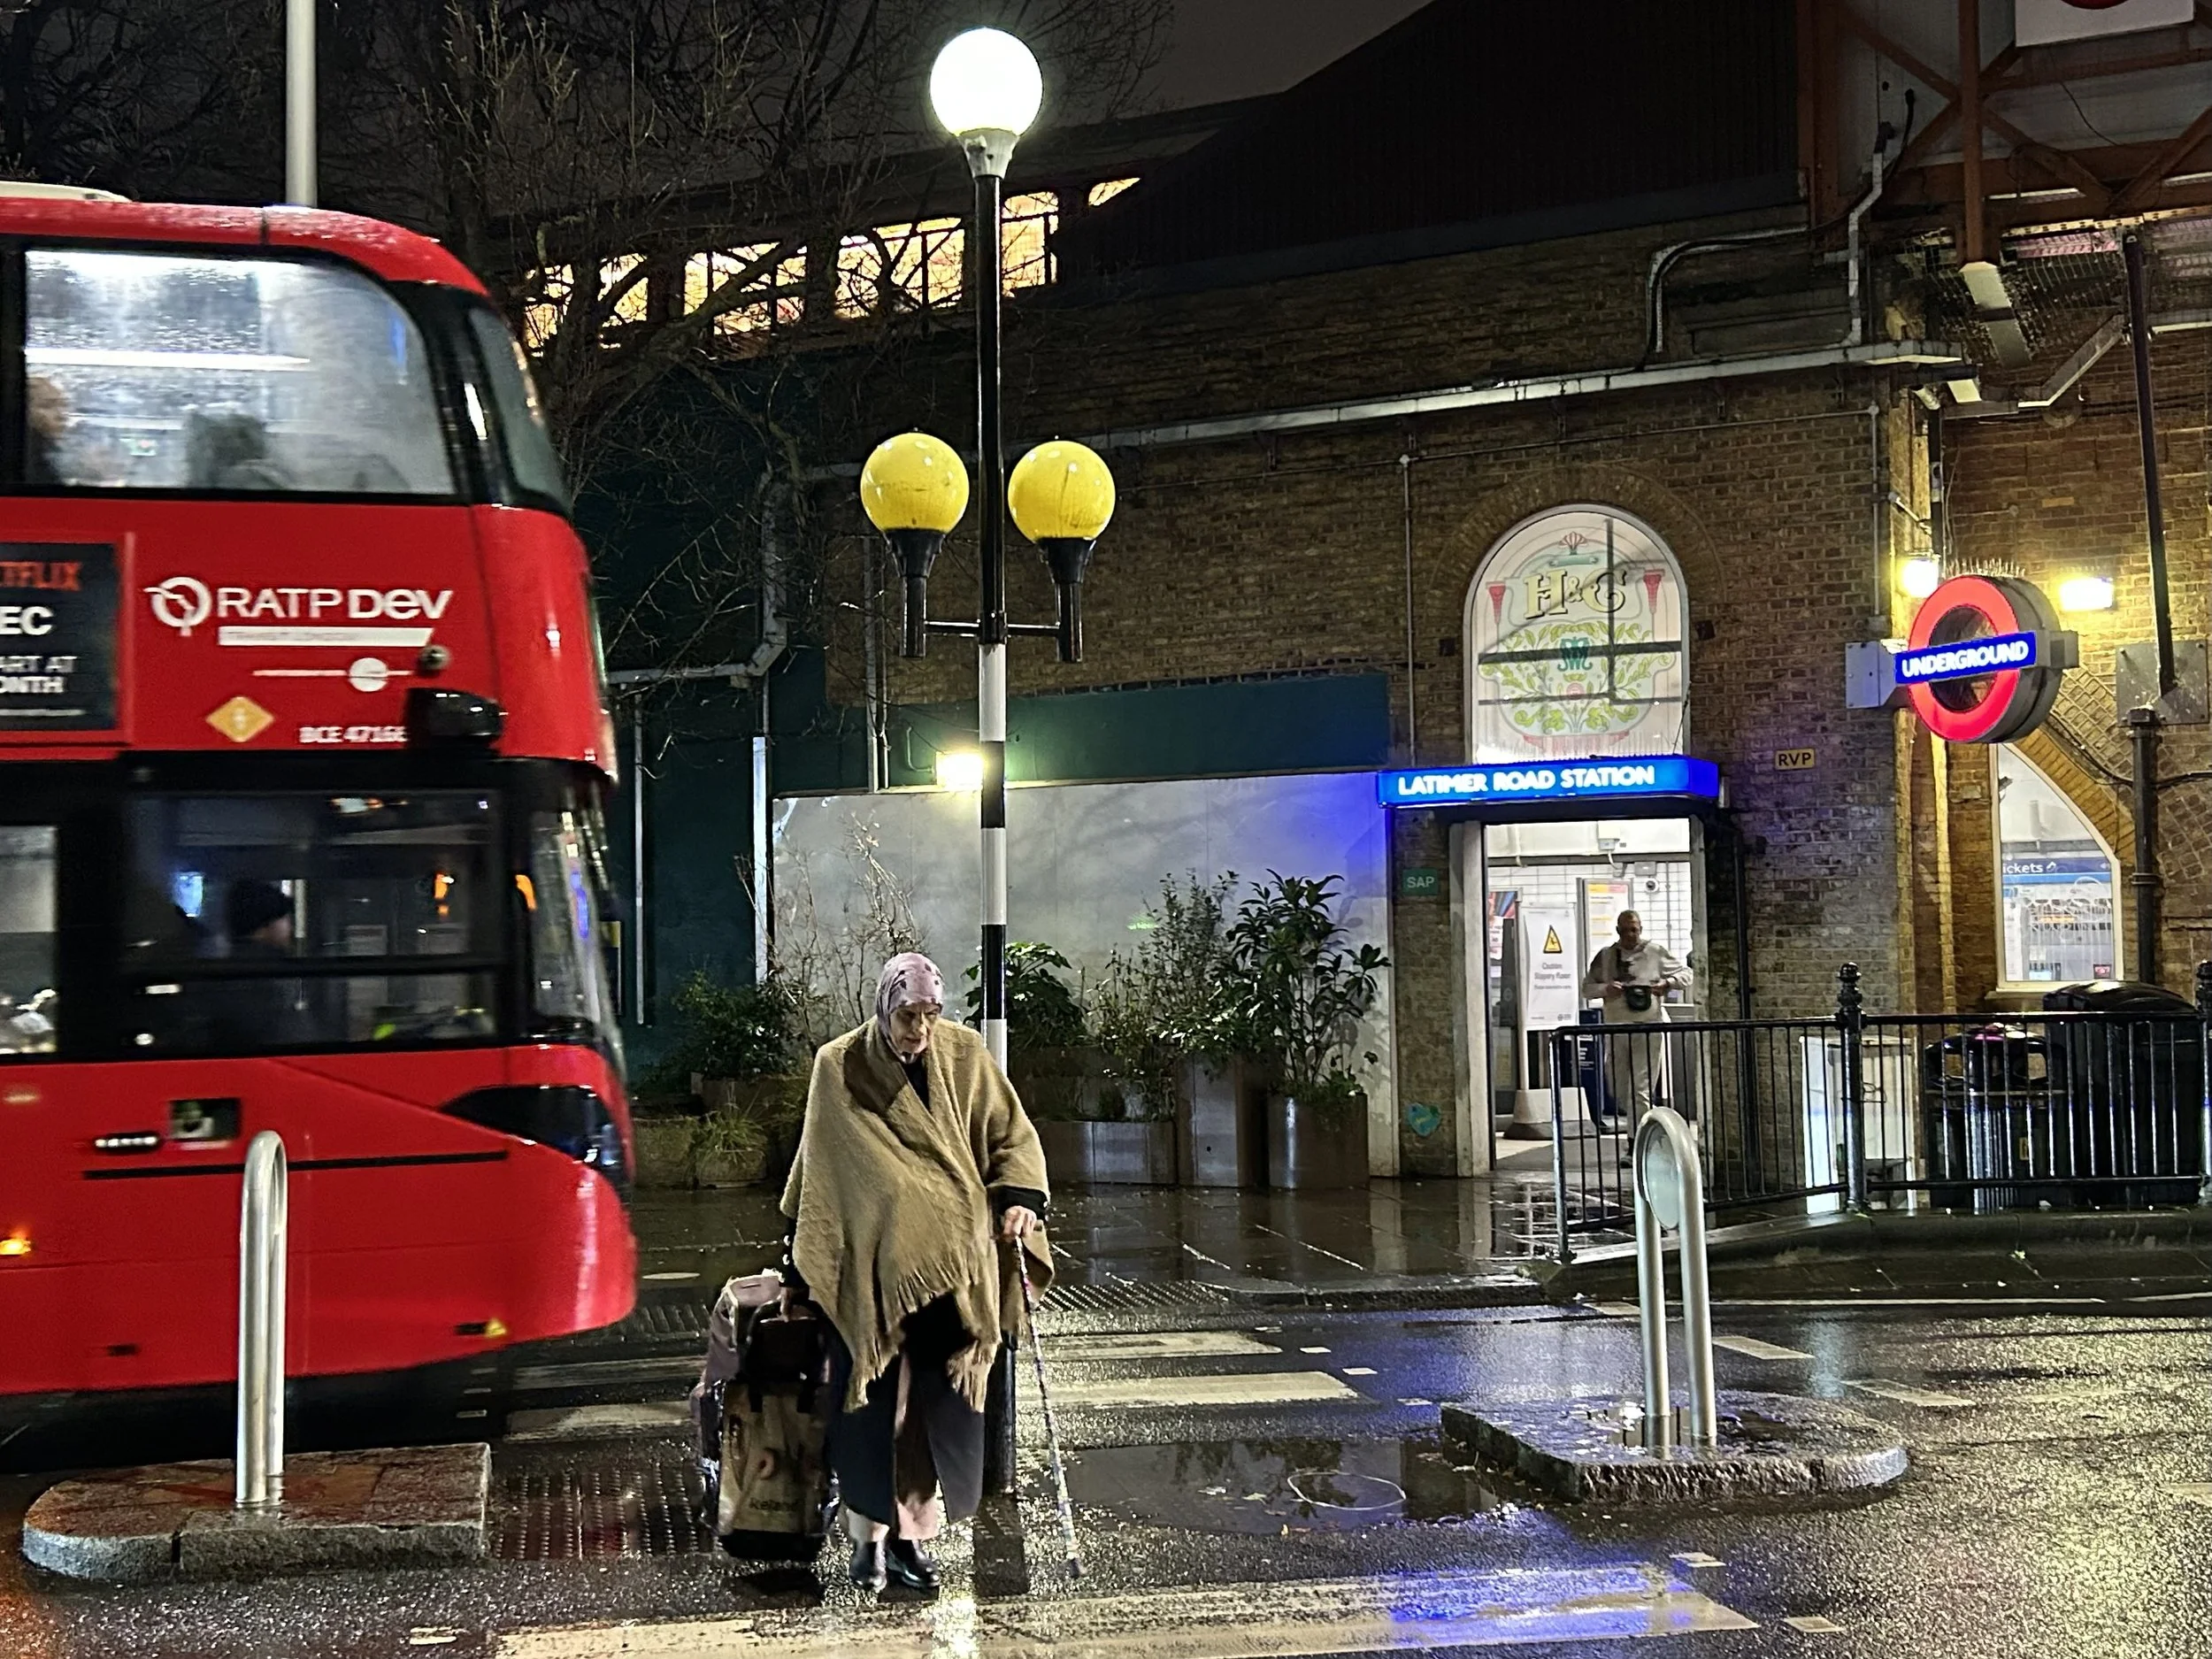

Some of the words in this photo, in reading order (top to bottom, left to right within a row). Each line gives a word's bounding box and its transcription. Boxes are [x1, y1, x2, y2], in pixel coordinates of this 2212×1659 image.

[218, 588, 343, 618] RATP
[1901, 641, 2029, 677] UNDERGROUND
[1778, 752, 1812, 766] RVP
[1398, 772, 1488, 795] LATIMER
[1493, 770, 1555, 792] ROAD
[1561, 765, 1655, 788] STATION
[1407, 876, 1435, 888] SAP
